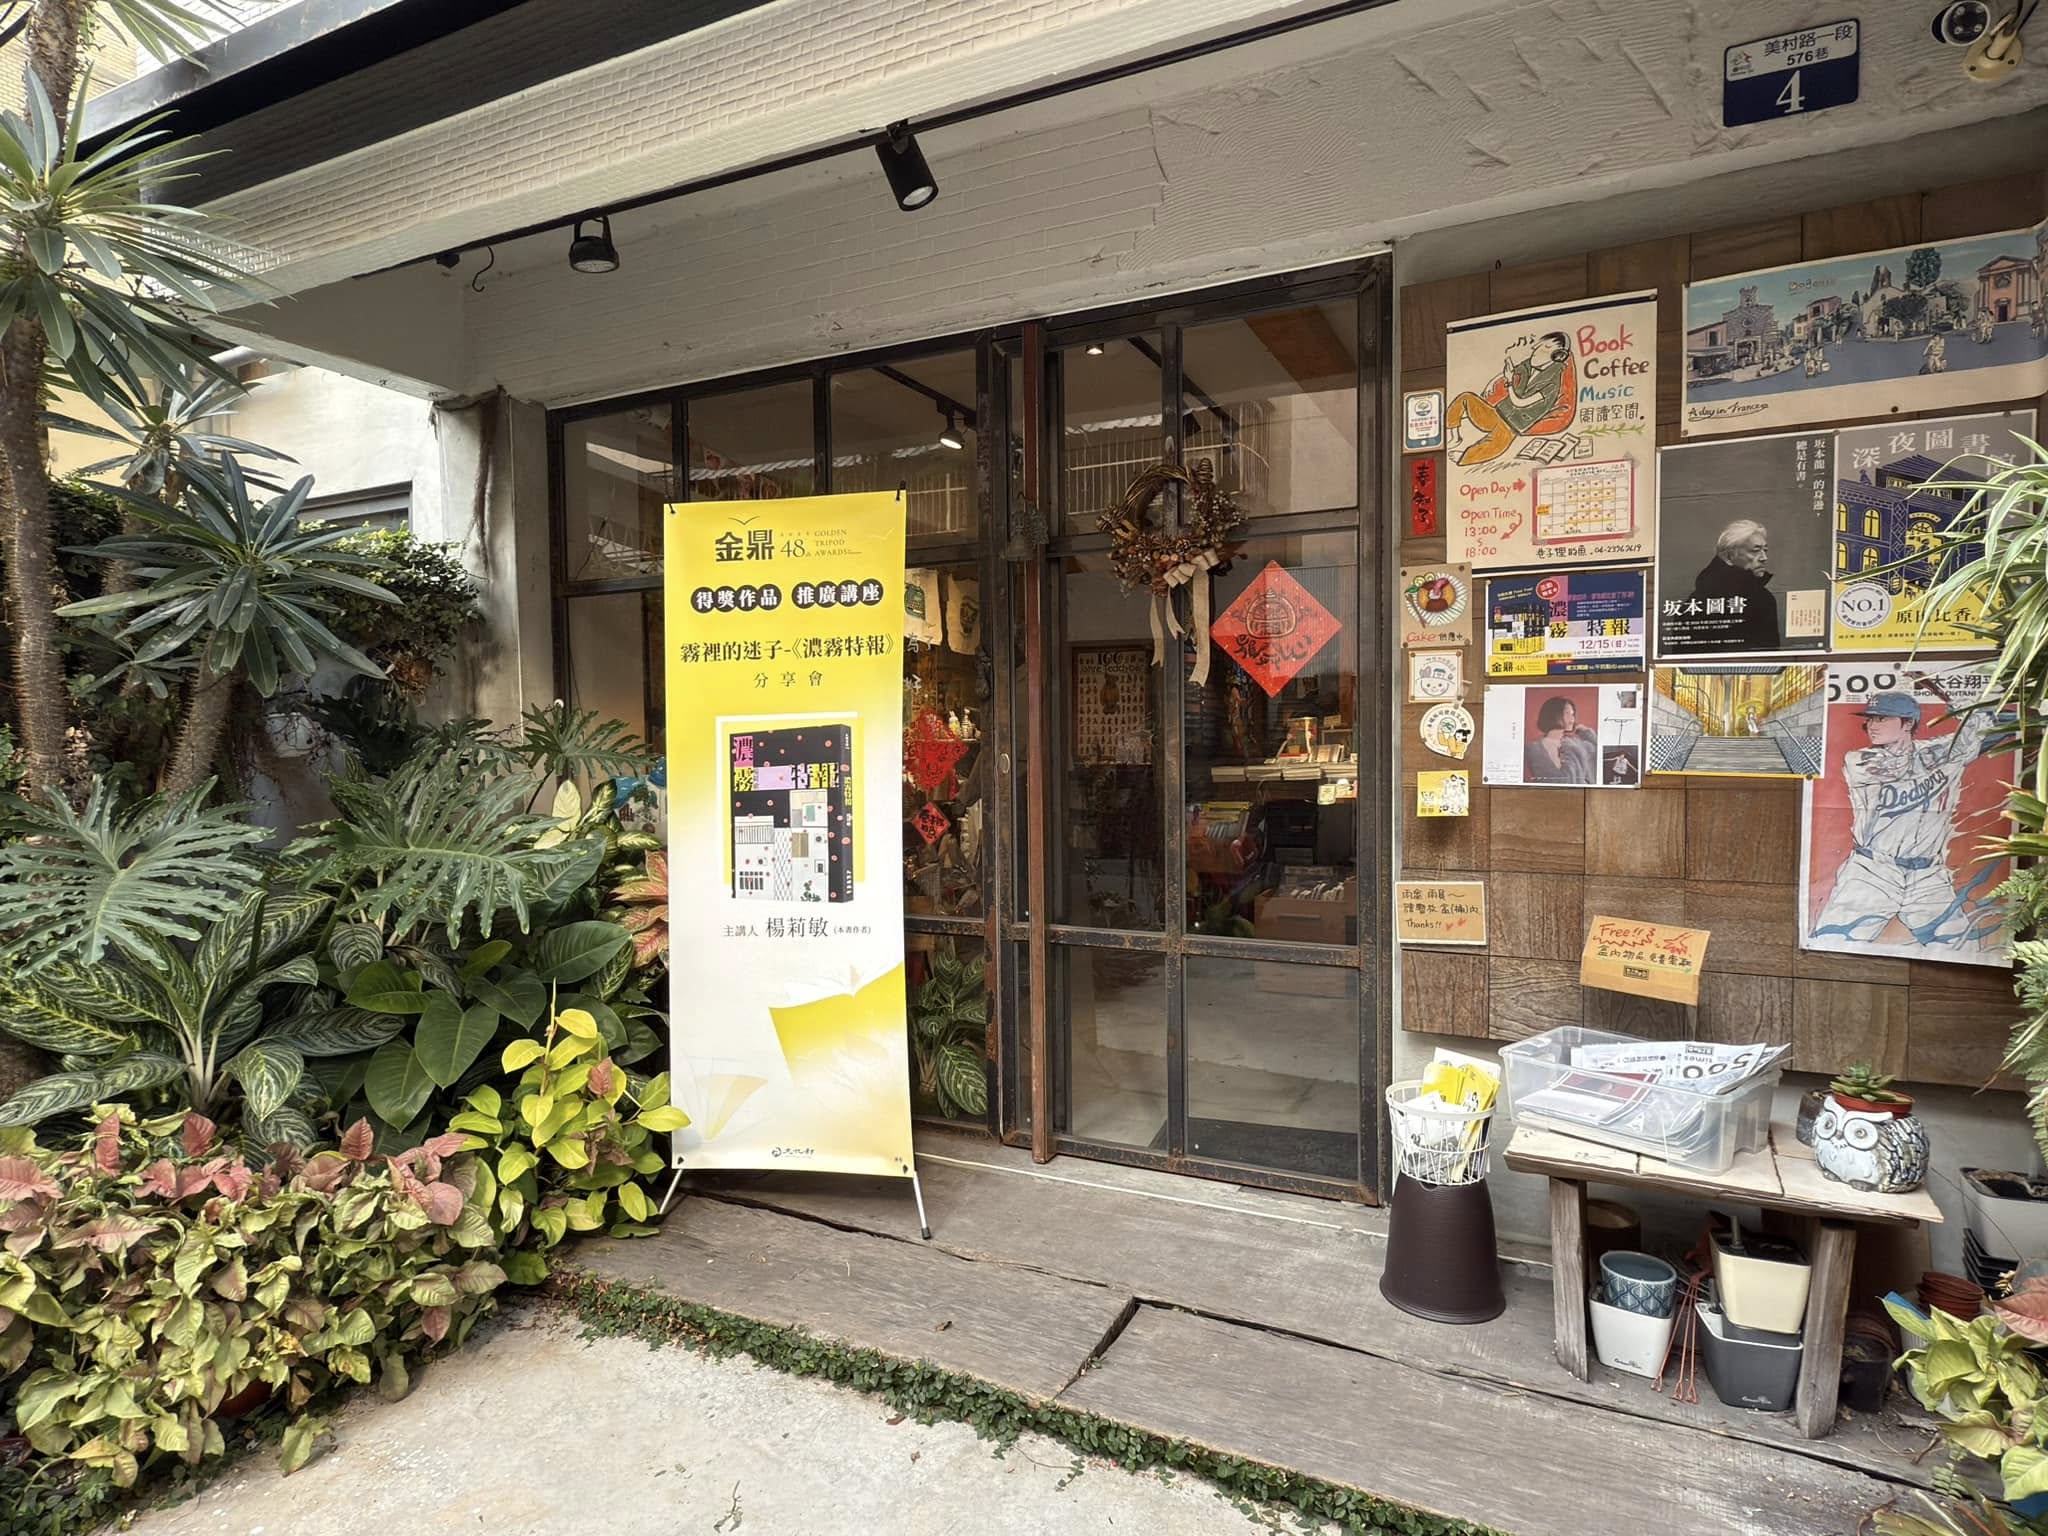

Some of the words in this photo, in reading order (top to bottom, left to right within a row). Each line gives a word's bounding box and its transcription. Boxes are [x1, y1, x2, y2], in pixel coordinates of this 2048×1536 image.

[1764, 24, 1854, 55] 美村路一段
[1787, 47, 1829, 66] 576巷
[1775, 70, 1806, 113] 4
[1576, 323, 1634, 357] Book
[1583, 356, 1650, 379] Coffee
[1580, 384, 1634, 403] Music
[1459, 484, 1489, 502] Open
[1490, 481, 1512, 499] Day
[1460, 509, 1490, 524] Open
[1491, 507, 1517, 519] Time
[814, 529, 847, 537] GOLDEN
[1464, 525, 1498, 537] 13:00
[715, 529, 775, 562] 金鼎
[815, 539, 845, 547] TRIPOD
[1465, 546, 1497, 558] 18:00
[815, 549, 848, 557] AWARDS
[696, 588, 778, 610] 得獎作品
[796, 583, 881, 606] 推廣講座
[1662, 595, 1748, 617] 坂本圖書
[1841, 597, 1884, 612] NO.1
[1586, 618, 1631, 636] 特報
[1407, 632, 1436, 642] Cake
[1491, 661, 1513, 673] 金鼎
[754, 670, 823, 689] 分享會
[723, 924, 759, 938] 主講人
[765, 916, 829, 938] 楊莉敏
[1405, 917, 1441, 928] Thanks!!
